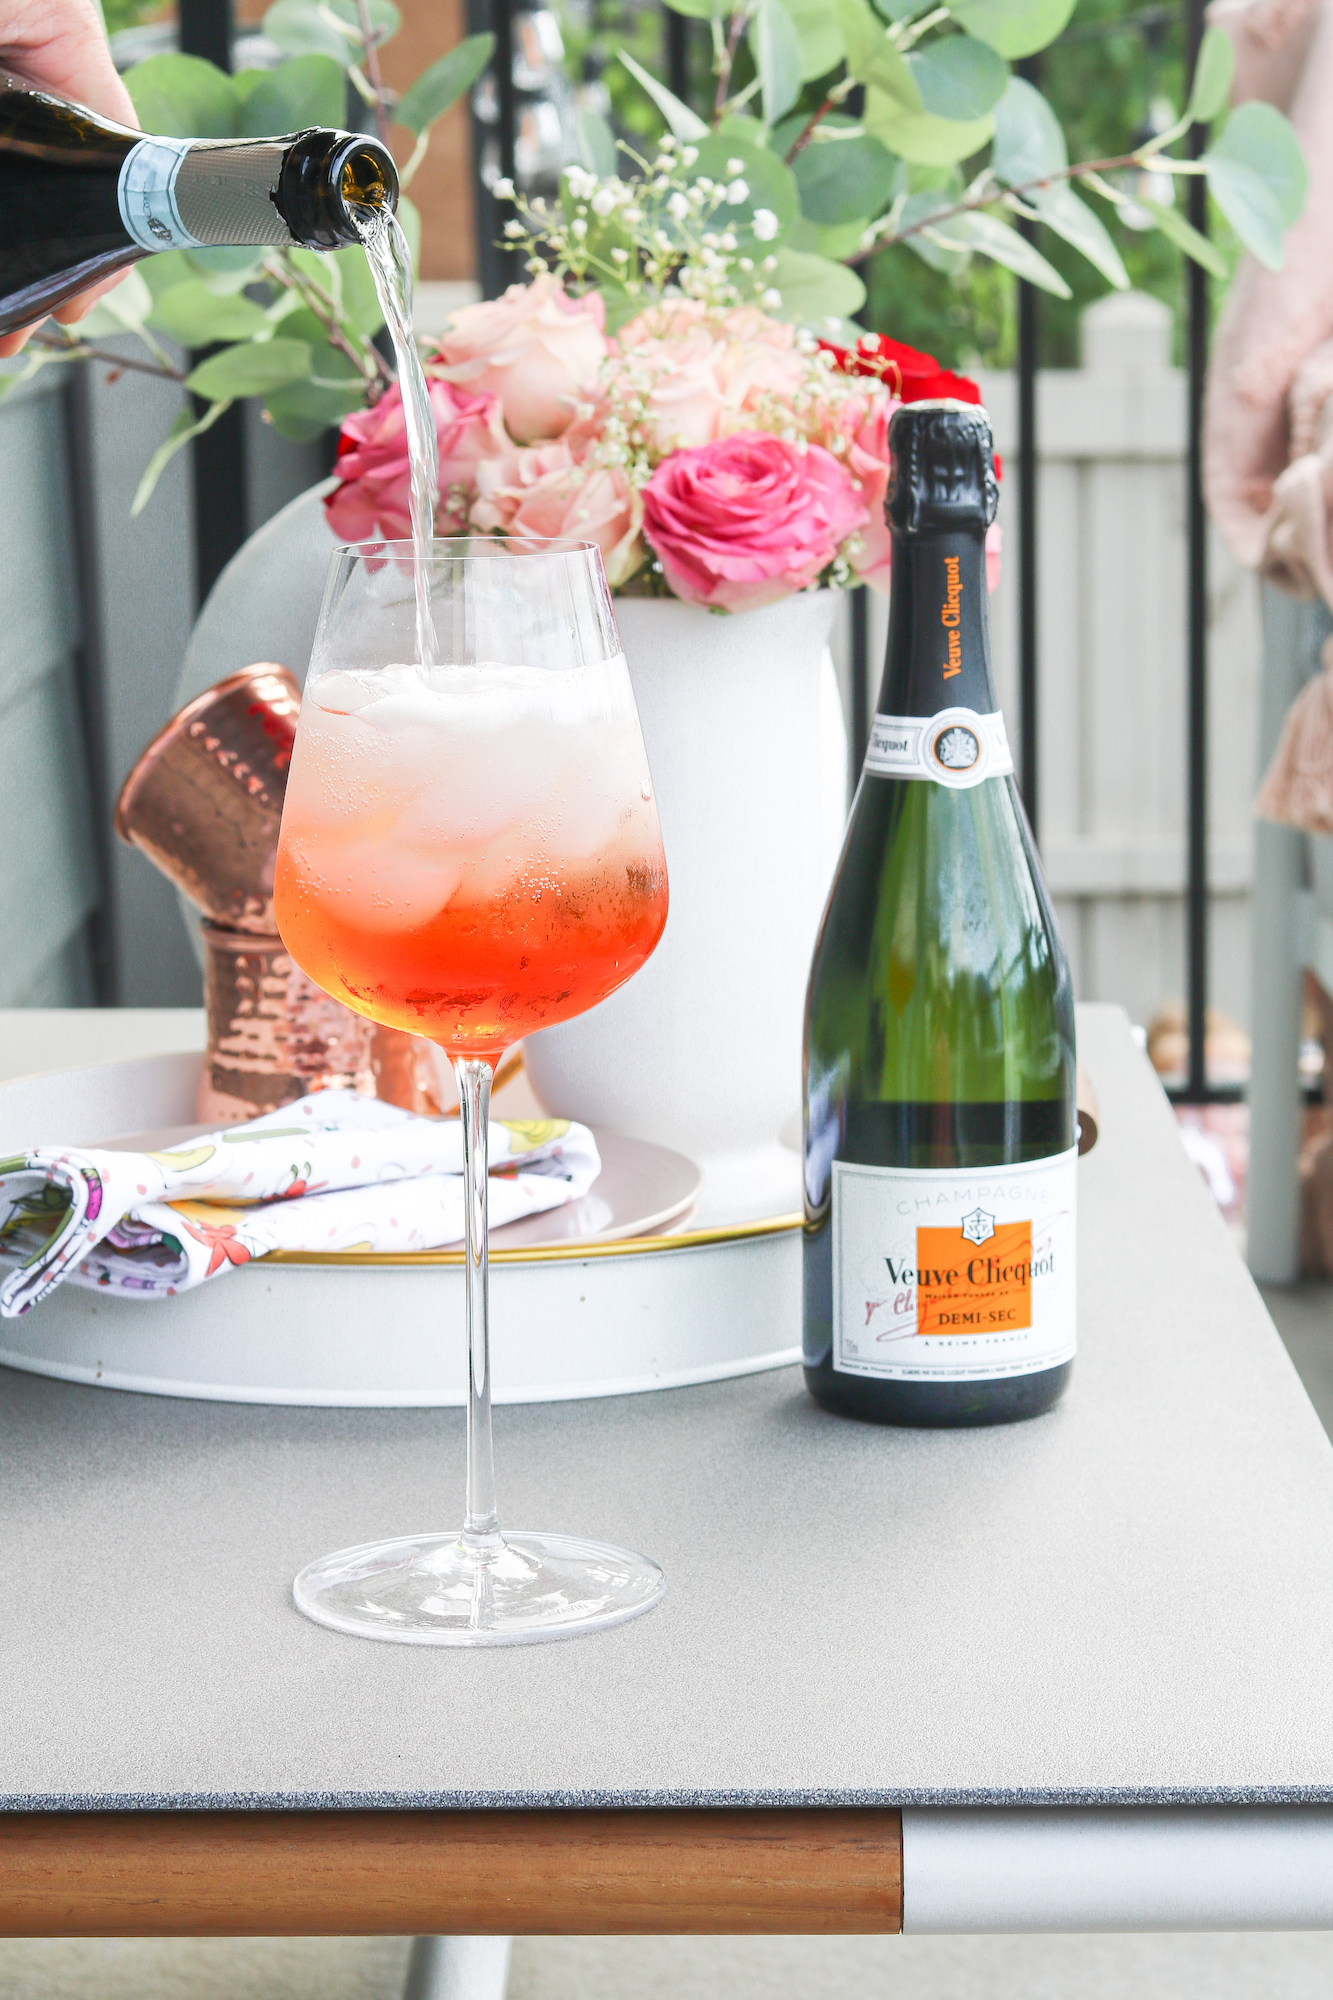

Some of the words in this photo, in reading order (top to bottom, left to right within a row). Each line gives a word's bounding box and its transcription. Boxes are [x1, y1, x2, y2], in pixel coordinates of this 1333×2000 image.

[942, 556, 963, 627] Clicquot
[943, 630, 962, 681] Veuve
[896, 1186, 1050, 1215] CHAMPAGNE
[885, 1257, 958, 1286] Veuve
[967, 1252, 1054, 1285] Clicquot
[938, 1308, 1017, 1325] DEMI-SEC
